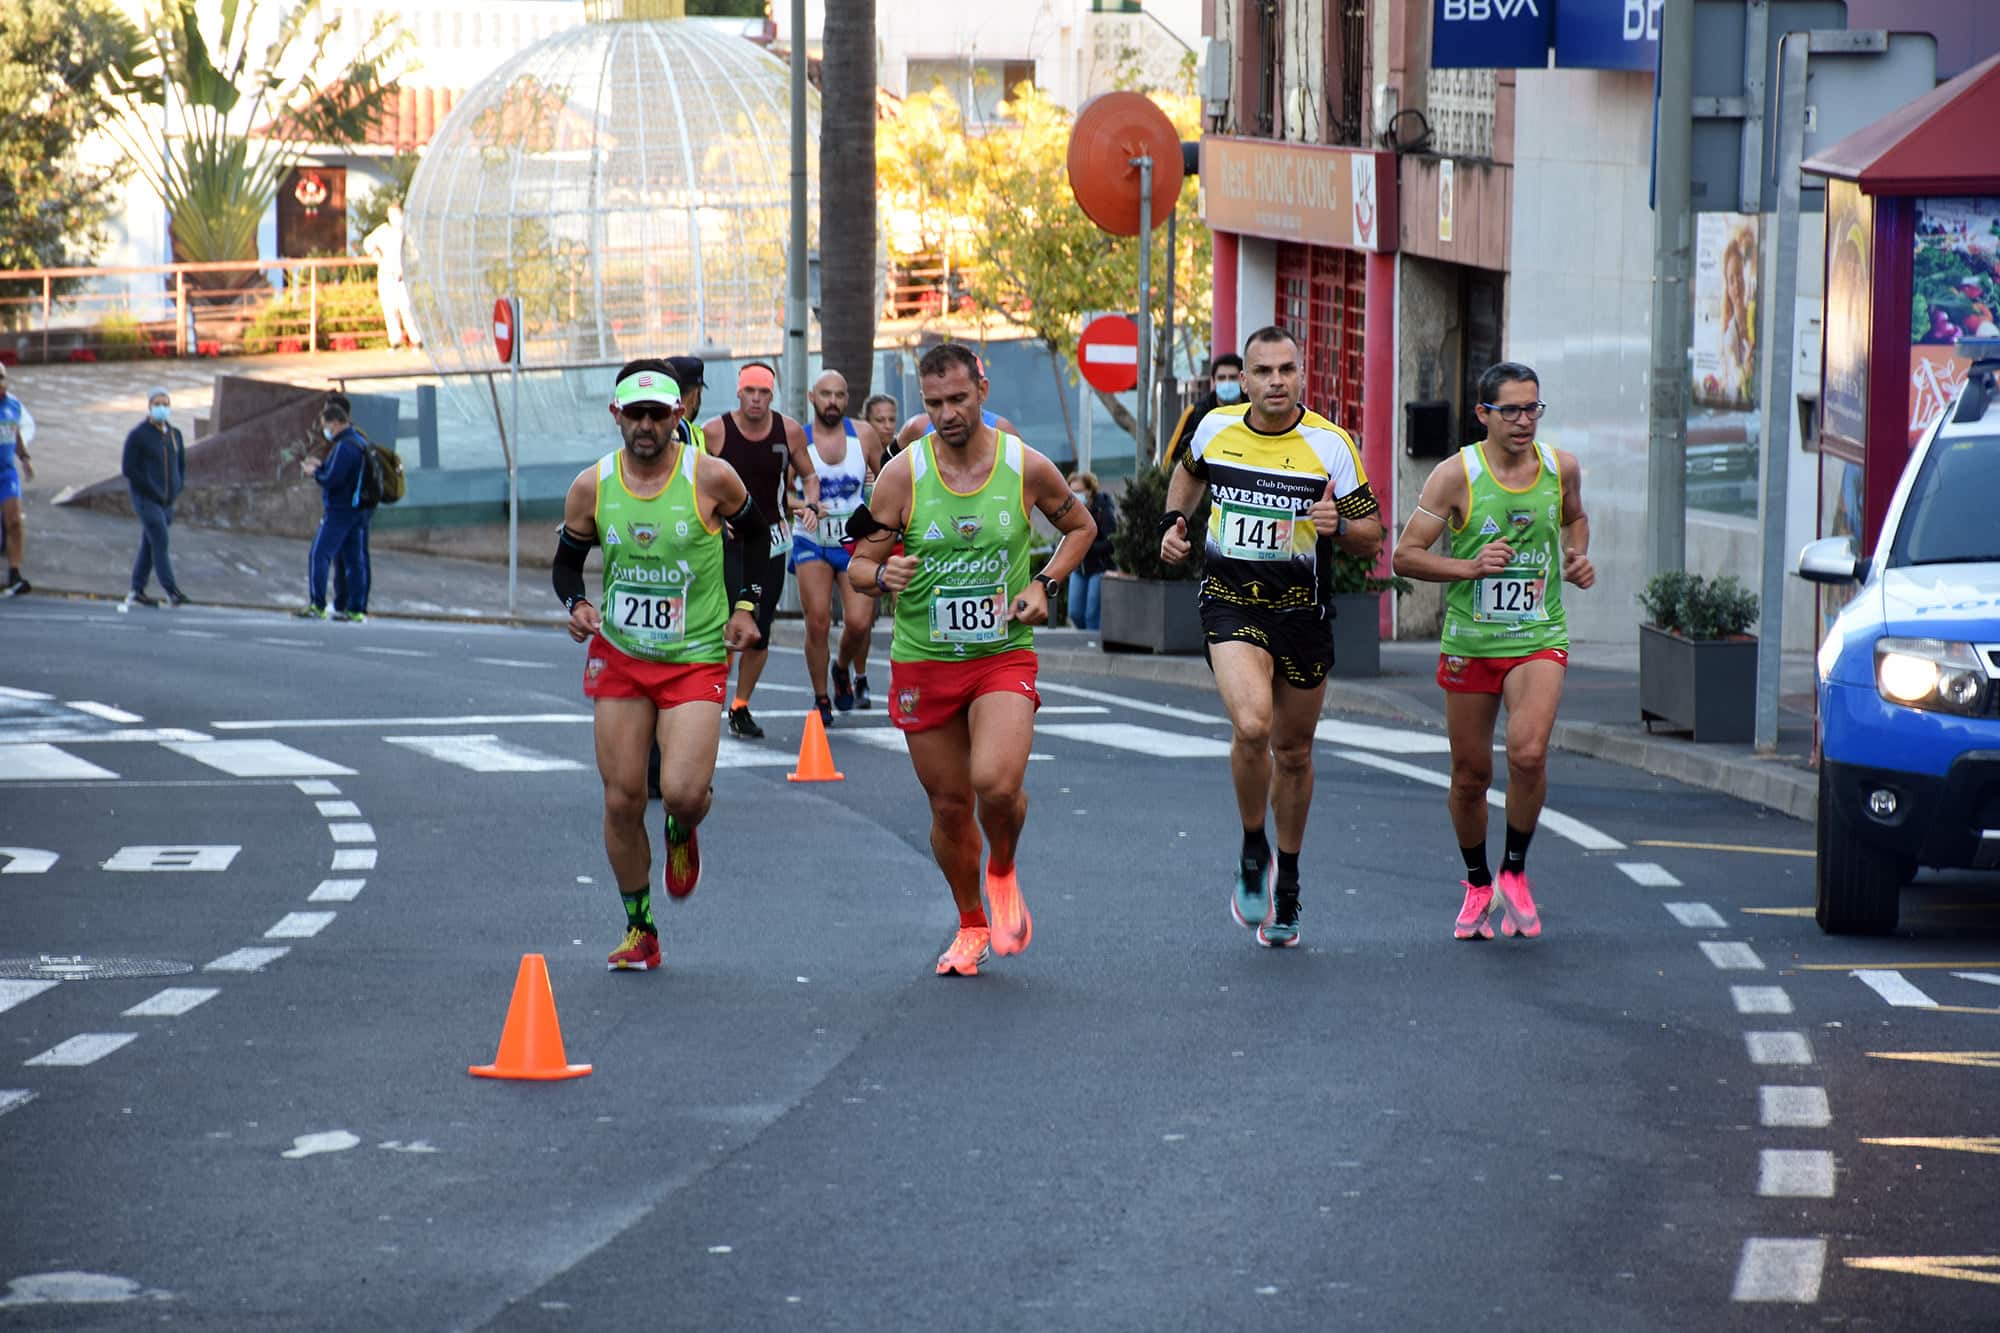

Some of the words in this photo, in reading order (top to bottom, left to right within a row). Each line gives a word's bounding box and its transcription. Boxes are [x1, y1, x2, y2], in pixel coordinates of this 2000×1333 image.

[1254, 152, 1294, 208] HONG
[1296, 156, 1337, 212] KONG
[1256, 478, 1276, 489] Club
[1276, 481, 1316, 494] Deportivo
[1234, 516, 1279, 550] 141
[923, 555, 999, 575] Curbelo
[623, 596, 671, 630] 218
[1491, 581, 1535, 612] 125
[945, 597, 996, 631] 183
